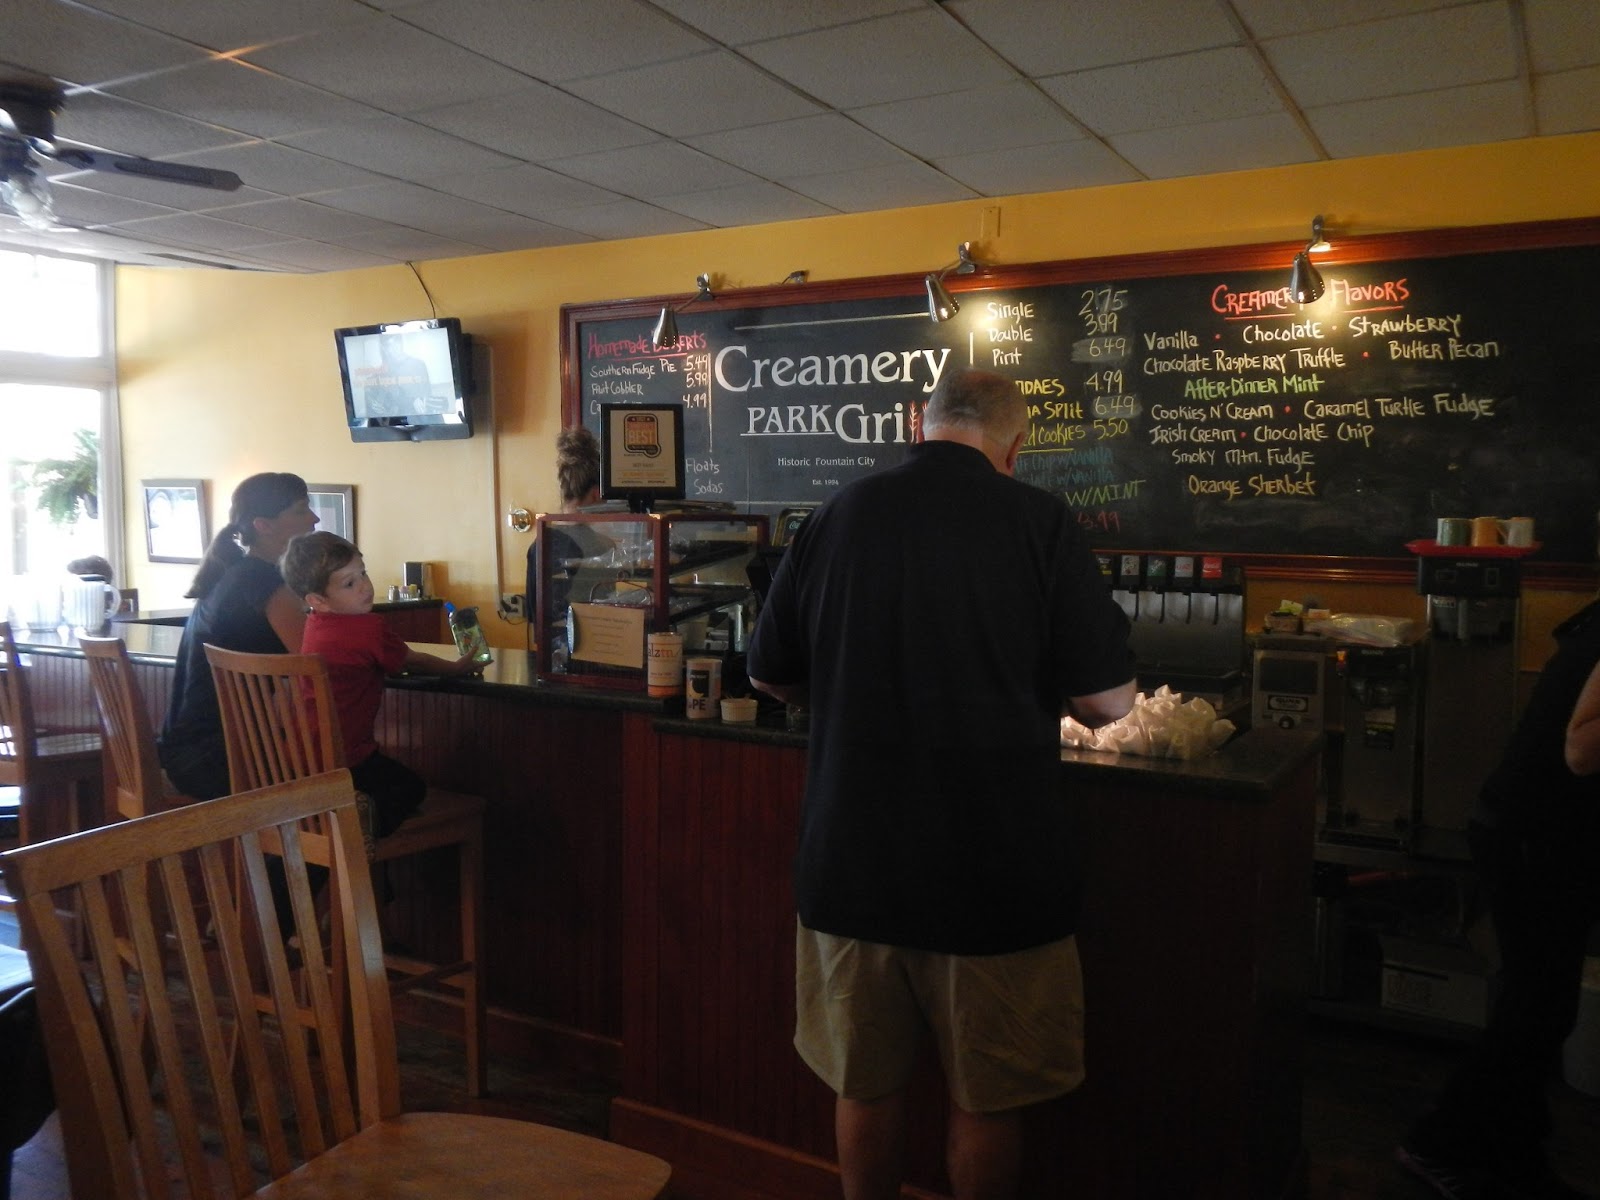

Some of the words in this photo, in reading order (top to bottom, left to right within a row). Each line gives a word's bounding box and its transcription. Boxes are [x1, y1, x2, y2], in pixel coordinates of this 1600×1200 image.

[1078, 289, 1128, 316] 2.75
[1144, 330, 1199, 350] Vanilla
[684, 355, 708, 372] 5.49
[992, 347, 1022, 367] Pint
[714, 345, 951, 393] Creamery
[686, 372, 708, 388] 5.99
[1084, 369, 1123, 394] 4.99
[1282, 373, 1325, 393] Mint
[682, 392, 708, 409] 4.99
[1432, 392, 1495, 421] Fudge
[747, 404, 836, 434] PARK
[1093, 416, 1129, 440] 5.50
[777, 456, 811, 467] Historic
[815, 456, 855, 467] Fountain
[857, 456, 876, 468] City
